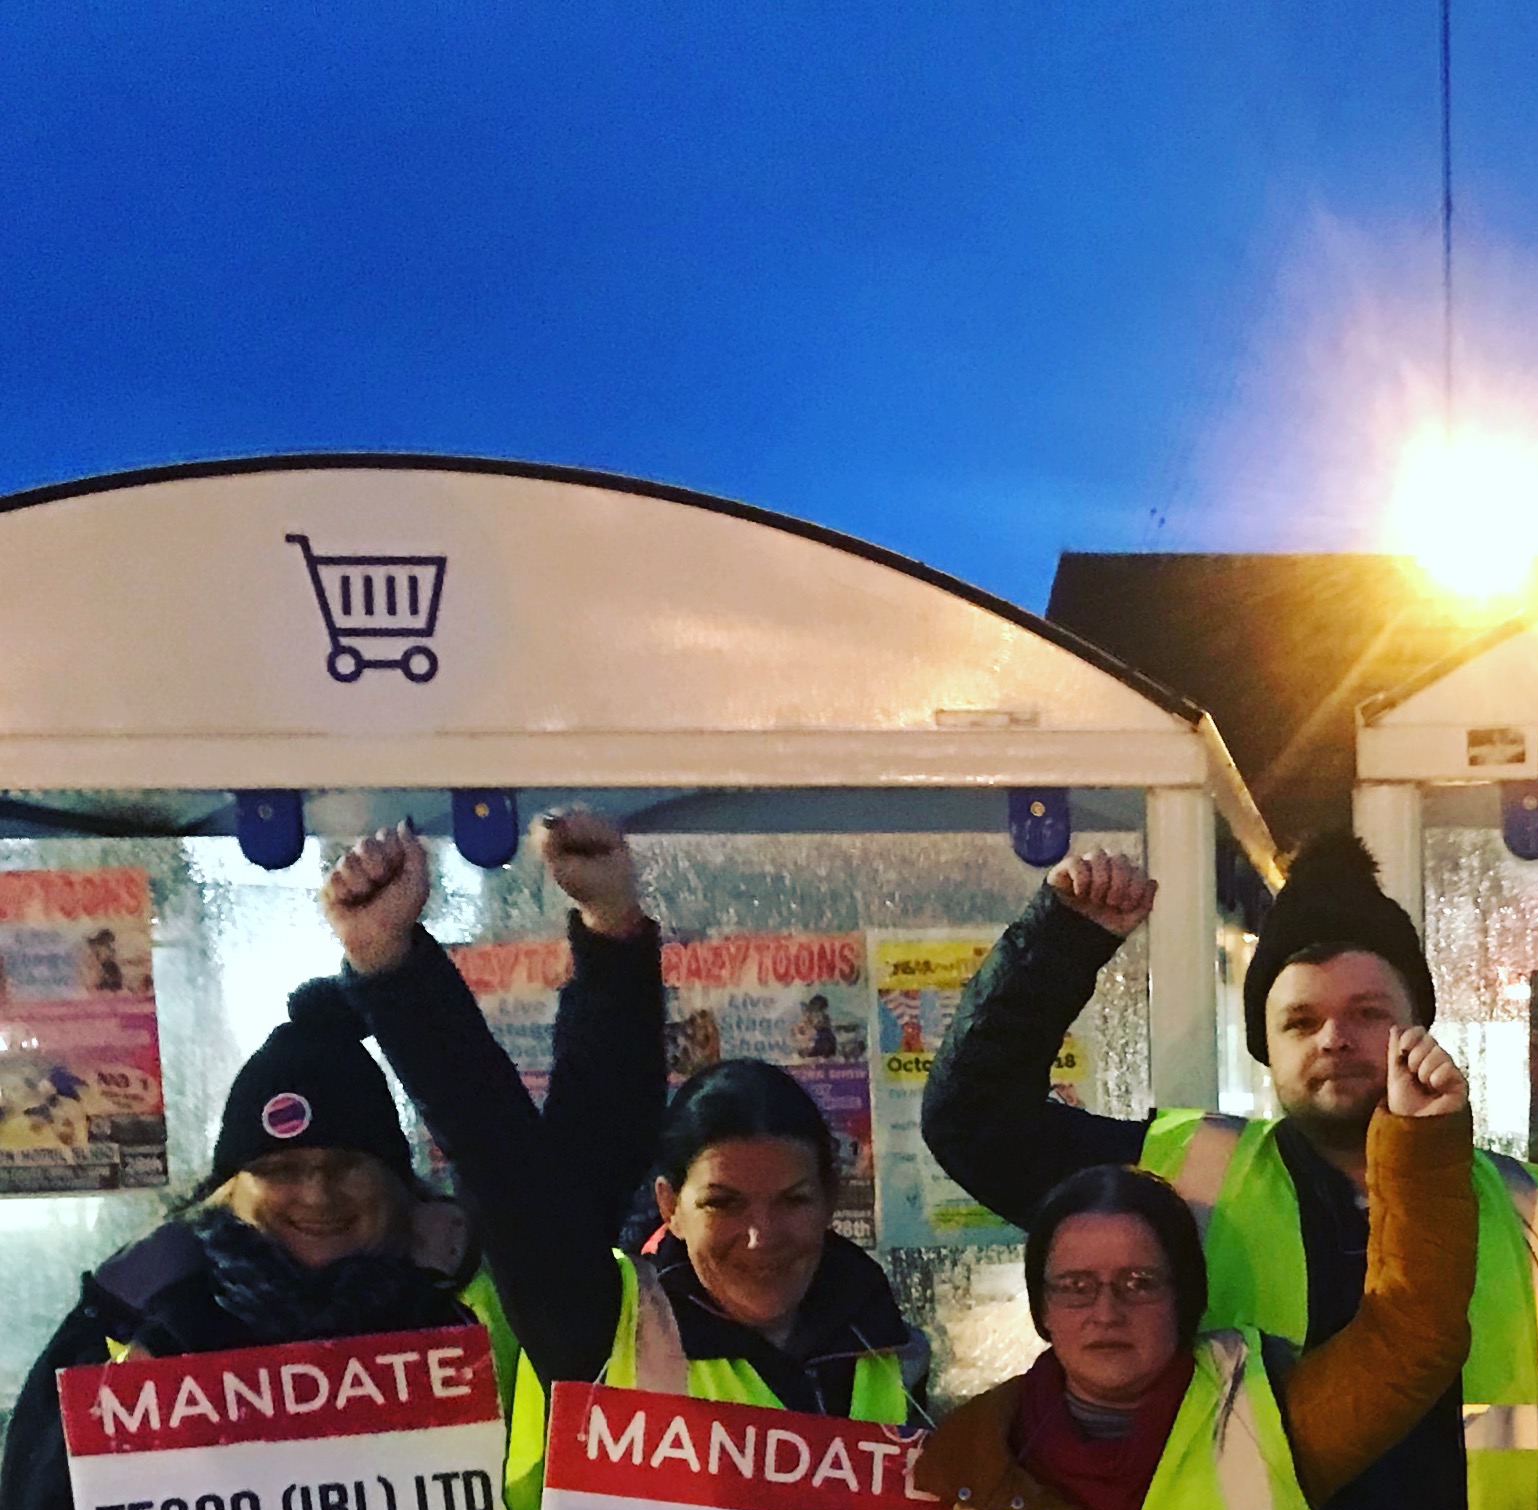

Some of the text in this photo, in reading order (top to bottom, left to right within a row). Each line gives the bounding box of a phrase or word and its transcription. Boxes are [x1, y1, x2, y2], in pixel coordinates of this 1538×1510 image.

[661, 940, 861, 988] RAZY TOONS
[98, 1346, 472, 1436] MANDATE
